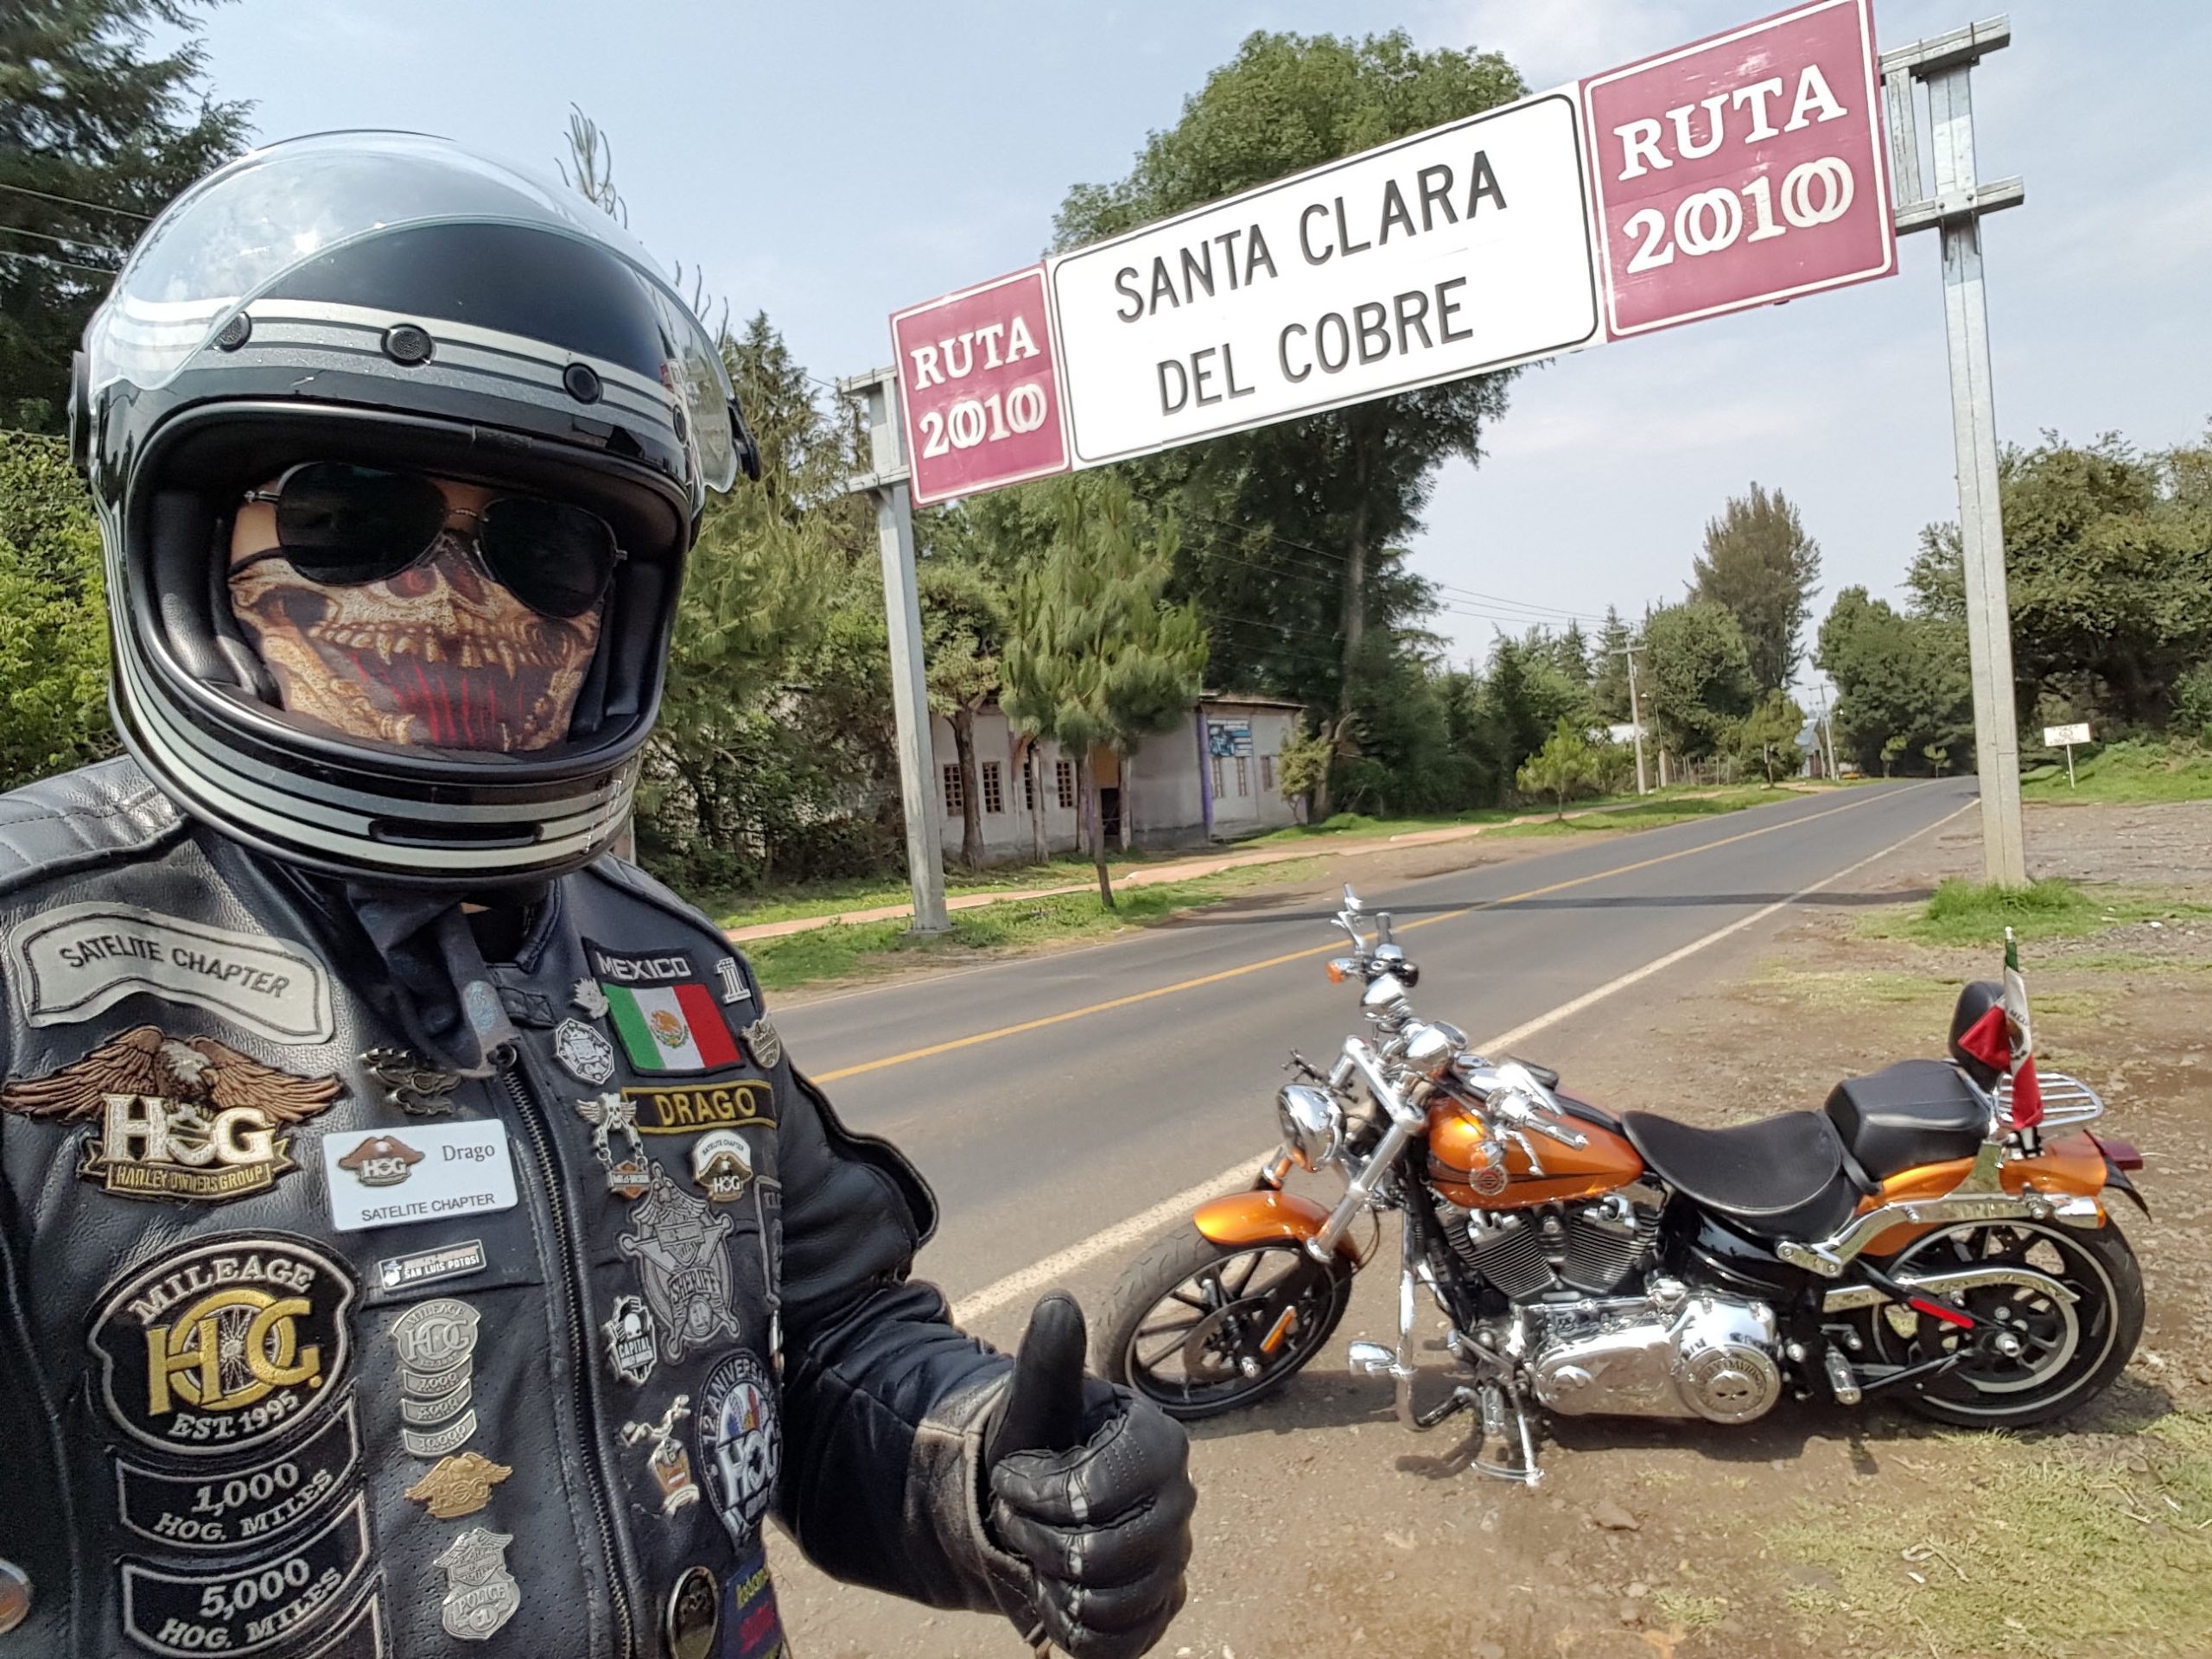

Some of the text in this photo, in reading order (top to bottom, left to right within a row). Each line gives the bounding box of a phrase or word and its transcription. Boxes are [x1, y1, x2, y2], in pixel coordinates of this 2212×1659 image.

[1612, 63, 1848, 181] RUTA
[1115, 149, 1508, 323] SANTA CLARA
[910, 315, 1041, 391] RUTA
[1156, 276, 1473, 417] DEL COBRE
[60, 935, 290, 998] SATELITE CHAPTER
[596, 952, 692, 980] MEXICO
[655, 1086, 757, 1126] DRAGO
[98, 1091, 276, 1166] HOG
[361, 1156, 407, 1179] HOG
[442, 1144, 495, 1162] Drago
[219, 1166, 263, 1191] GROUP
[713, 1175, 741, 1192] HOG
[360, 1192, 496, 1223] SATELITE CHAPTER
[128, 1255, 316, 1325] MILEAGE
[404, 1268, 423, 1280] SAN
[424, 1262, 446, 1275] LUIS
[671, 1269, 719, 1305] SHERIFF
[406, 1305, 466, 1325] MILEAGE
[404, 1319, 470, 1362] HOG
[618, 1336, 652, 1358] CAPITAL
[168, 1389, 301, 1440] EST. 1995
[152, 1469, 334, 1541] HOG. MILES
[190, 1462, 300, 1516] 1,000
[432, 1475, 489, 1509] HOG
[156, 1566, 344, 1649] HOG. MILES
[199, 1558, 310, 1621] 5,000
[458, 1586, 507, 1613] POLICE
